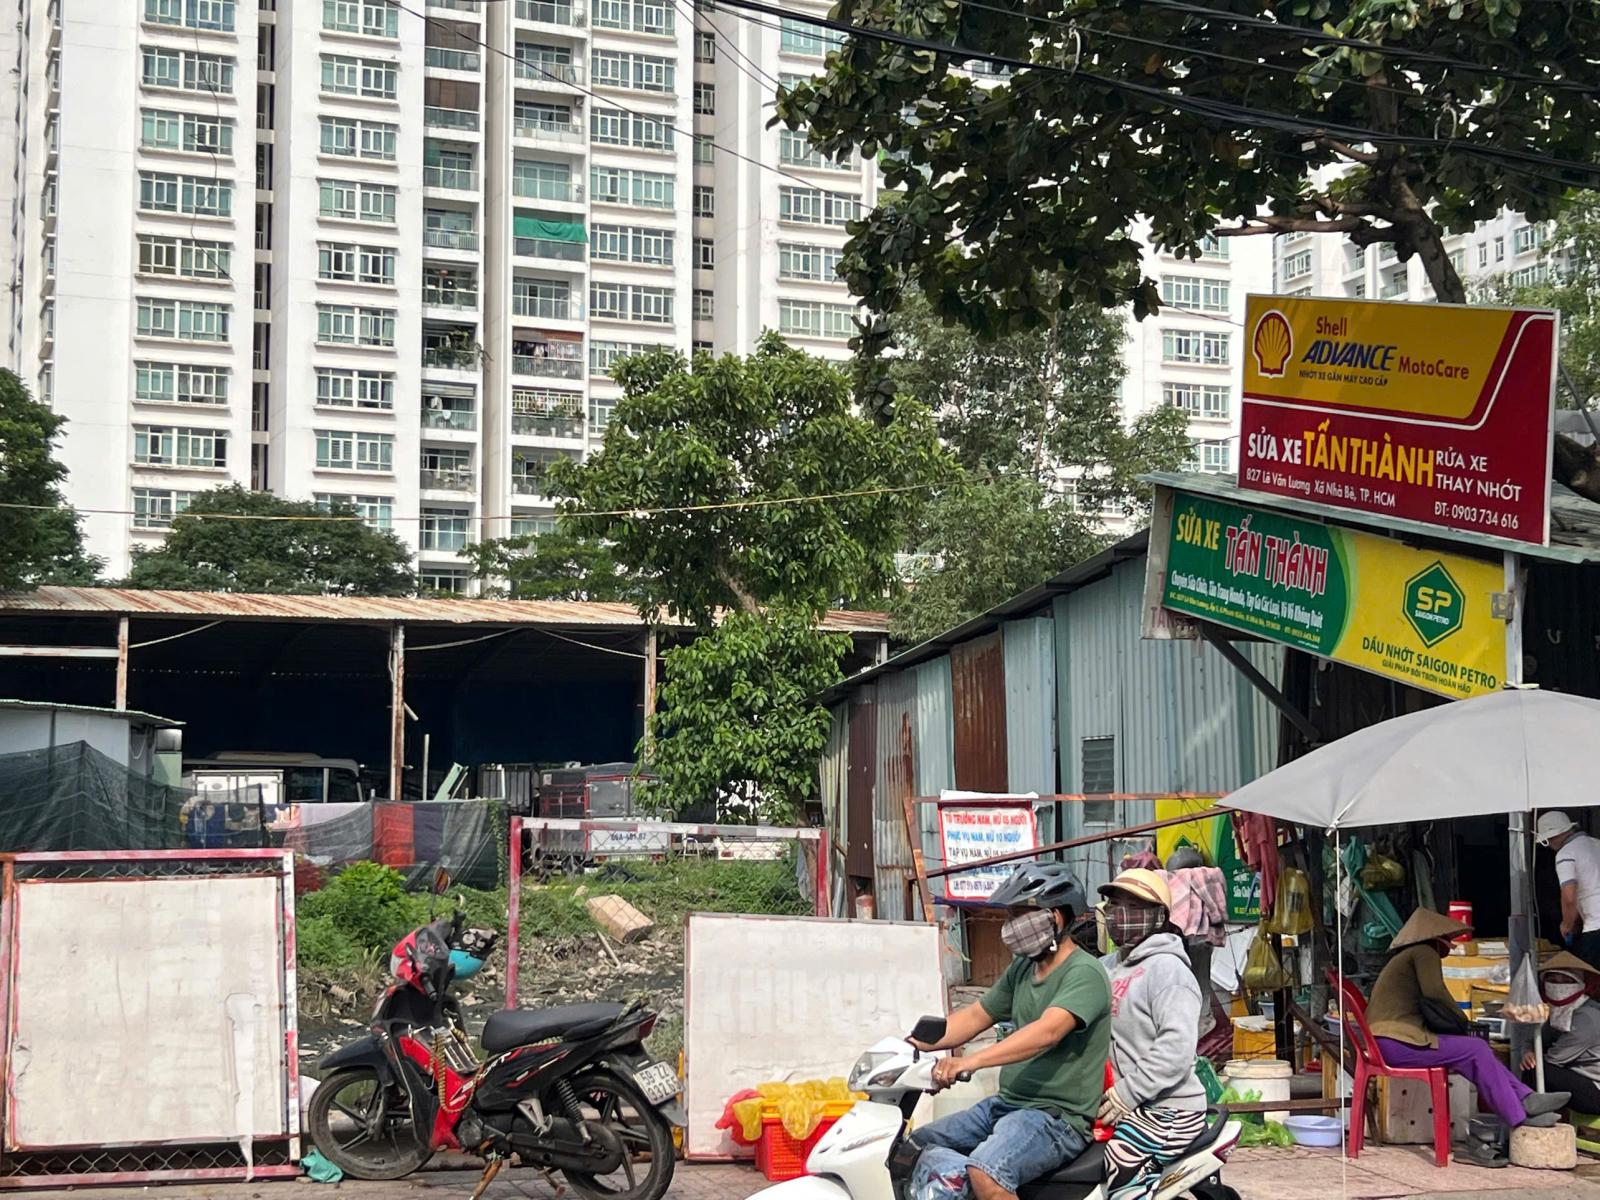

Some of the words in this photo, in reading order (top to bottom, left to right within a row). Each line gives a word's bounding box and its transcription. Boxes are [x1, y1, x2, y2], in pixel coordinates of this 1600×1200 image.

[1316, 316, 1347, 337] Shell
[1301, 339, 1398, 371] ADVANCE
[1399, 356, 1470, 380] MotoCare
[1247, 426, 1278, 462] SỬA
[1281, 438, 1302, 465] XE
[1436, 446, 1465, 469] RỬA
[1469, 455, 1488, 472] XE
[1246, 468, 1261, 482] 827
[1262, 471, 1271, 484] Lê
[1272, 472, 1287, 487] Văn
[1326, 481, 1343, 498] Nhà
[1374, 490, 1396, 507] HCM
[1436, 474, 1474, 493] THAY
[1477, 479, 1522, 502] NHỚT
[1452, 504, 1477, 523] 0903
[1479, 509, 1498, 526] 734
[1501, 513, 1519, 529] 616
[1176, 506, 1201, 547] SỬA
[1203, 518, 1221, 550] XE
[1265, 530, 1328, 598] THÀNH
[1416, 586, 1452, 613] SP
[1386, 645, 1414, 664] NHỚT
[1416, 653, 1457, 678] SAIGON
[1460, 666, 1496, 689] PETRO
